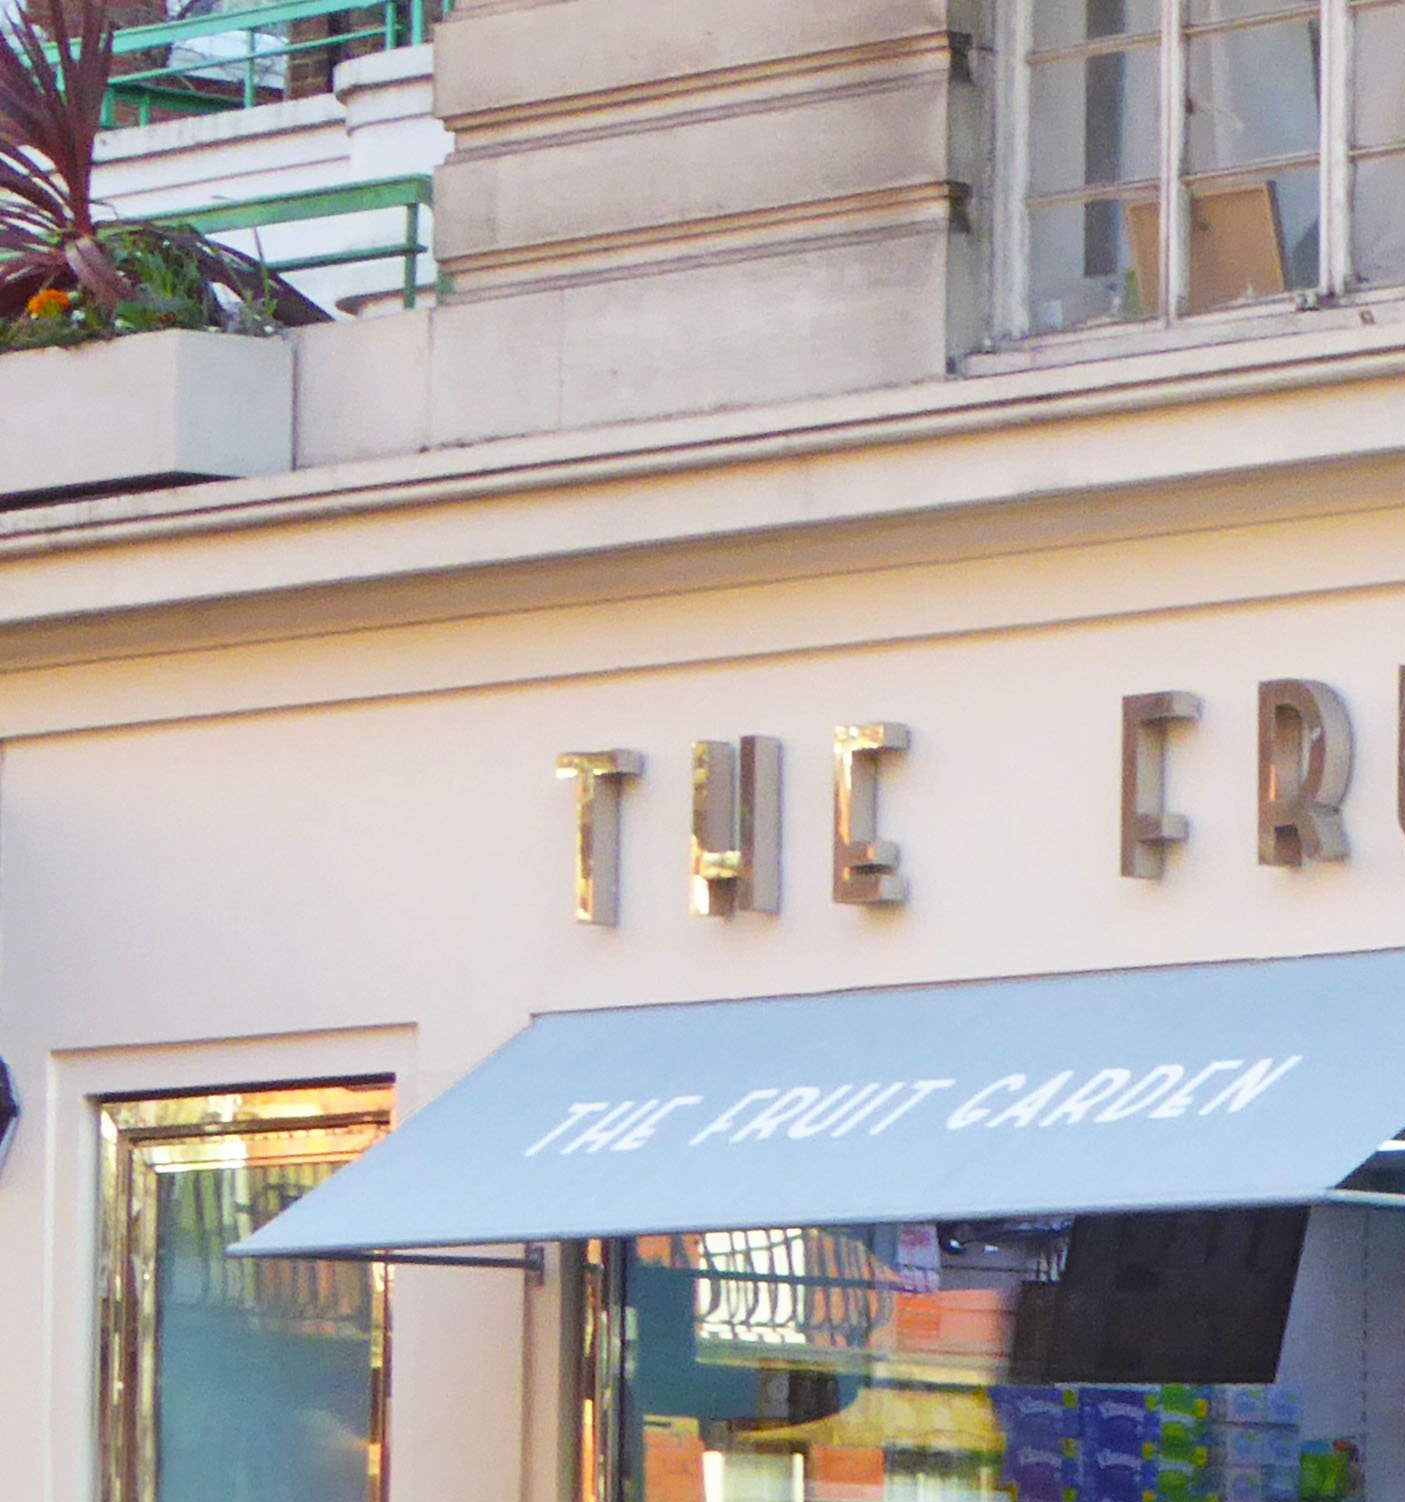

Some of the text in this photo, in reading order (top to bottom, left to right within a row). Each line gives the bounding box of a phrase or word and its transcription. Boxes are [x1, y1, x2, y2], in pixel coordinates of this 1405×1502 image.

[554, 722, 911, 927] THE
[525, 1054, 1302, 1157] THE FRUIT GARDEN
